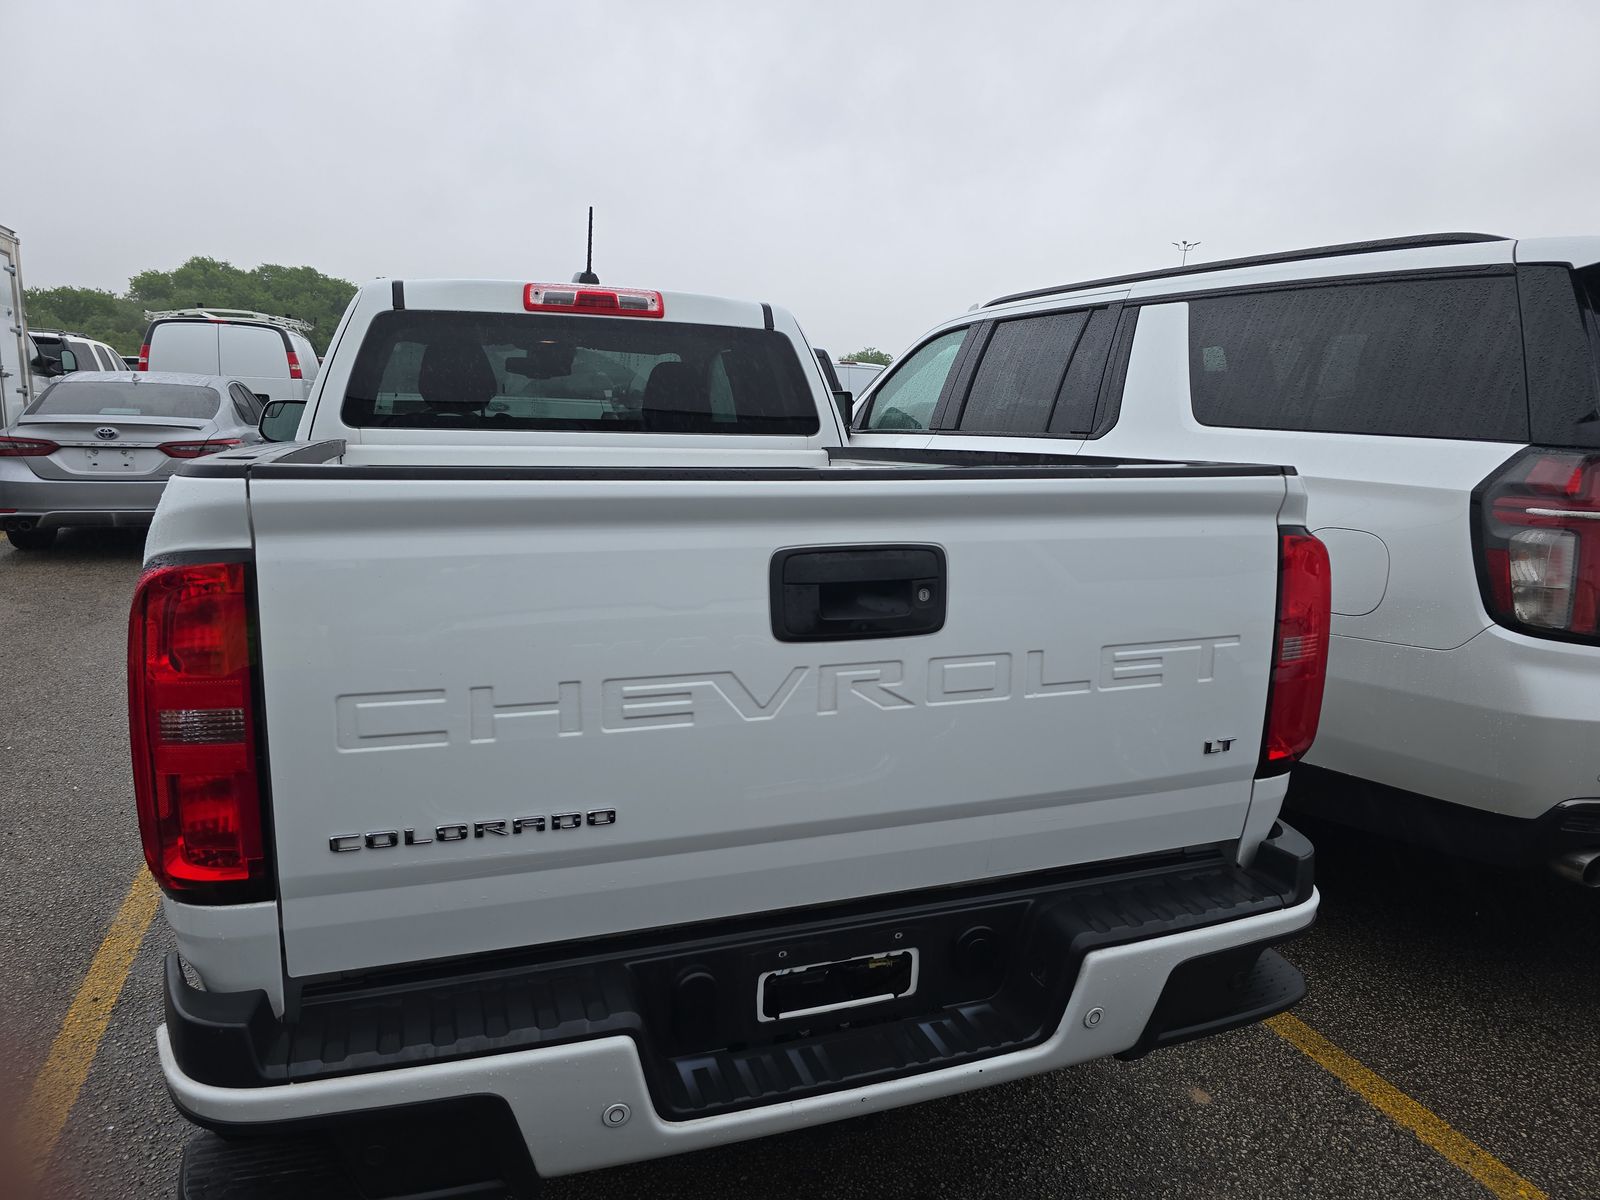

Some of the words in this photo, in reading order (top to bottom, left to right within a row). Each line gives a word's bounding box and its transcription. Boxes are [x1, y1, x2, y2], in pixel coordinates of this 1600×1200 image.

[335, 634, 1241, 753] CHEVROLET
[1204, 737, 1237, 754] LT
[329, 808, 616, 853] COLORADO
